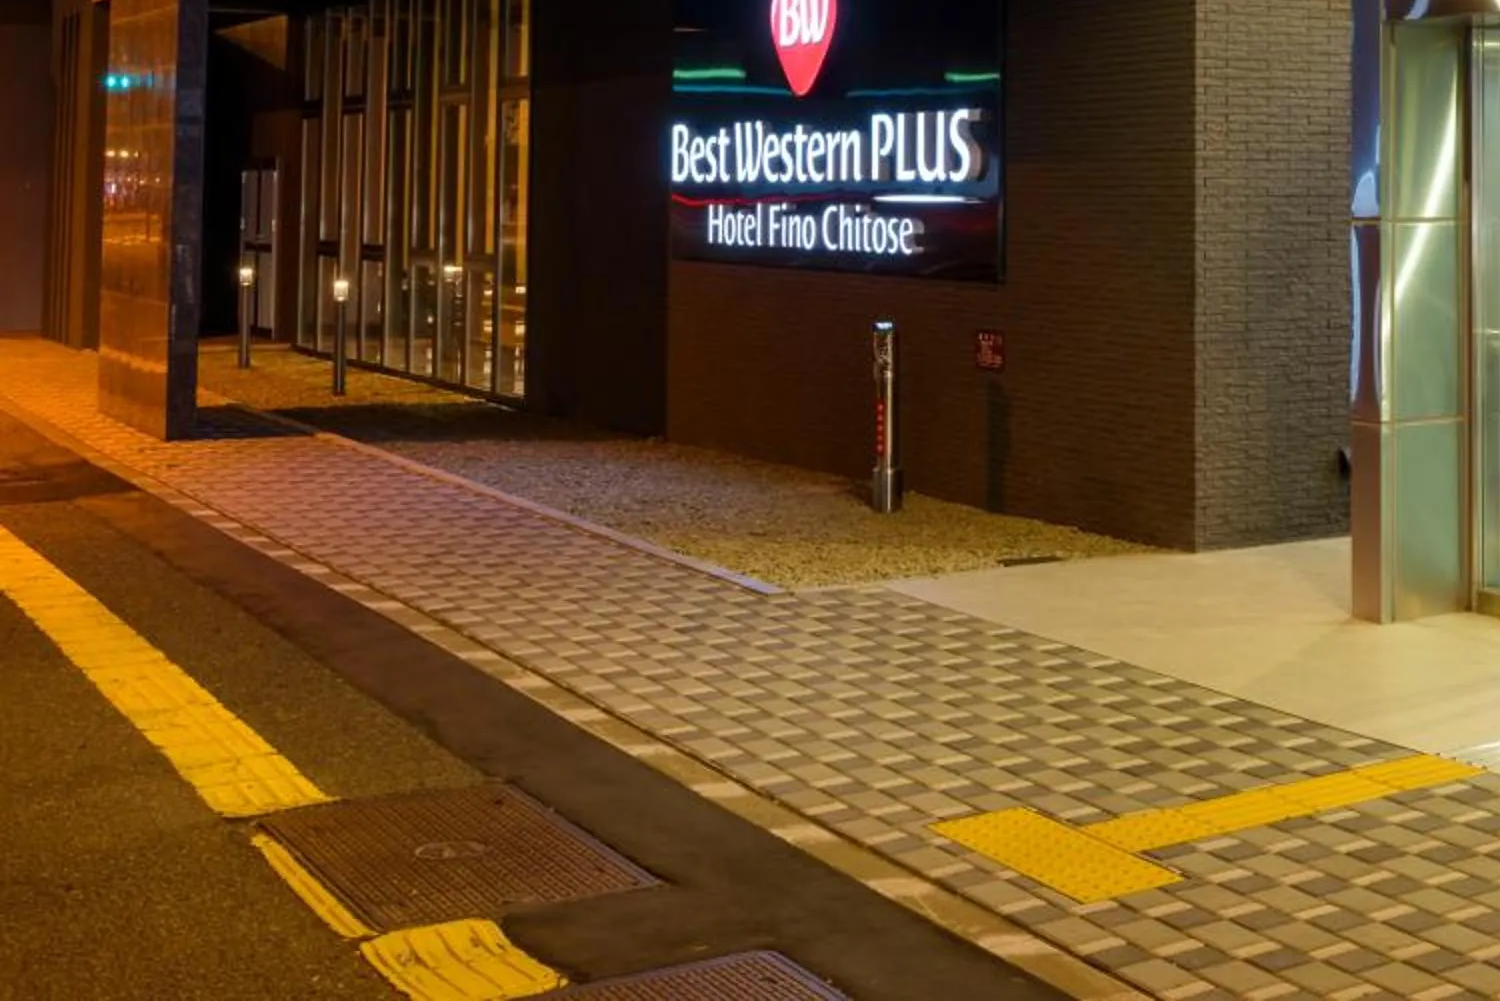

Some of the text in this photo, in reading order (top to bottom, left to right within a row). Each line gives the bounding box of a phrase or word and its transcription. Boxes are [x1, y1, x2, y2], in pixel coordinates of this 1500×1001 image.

[671, 108, 972, 183] Best Western PLUS
[707, 203, 914, 254] Hotel Fino Chitose
